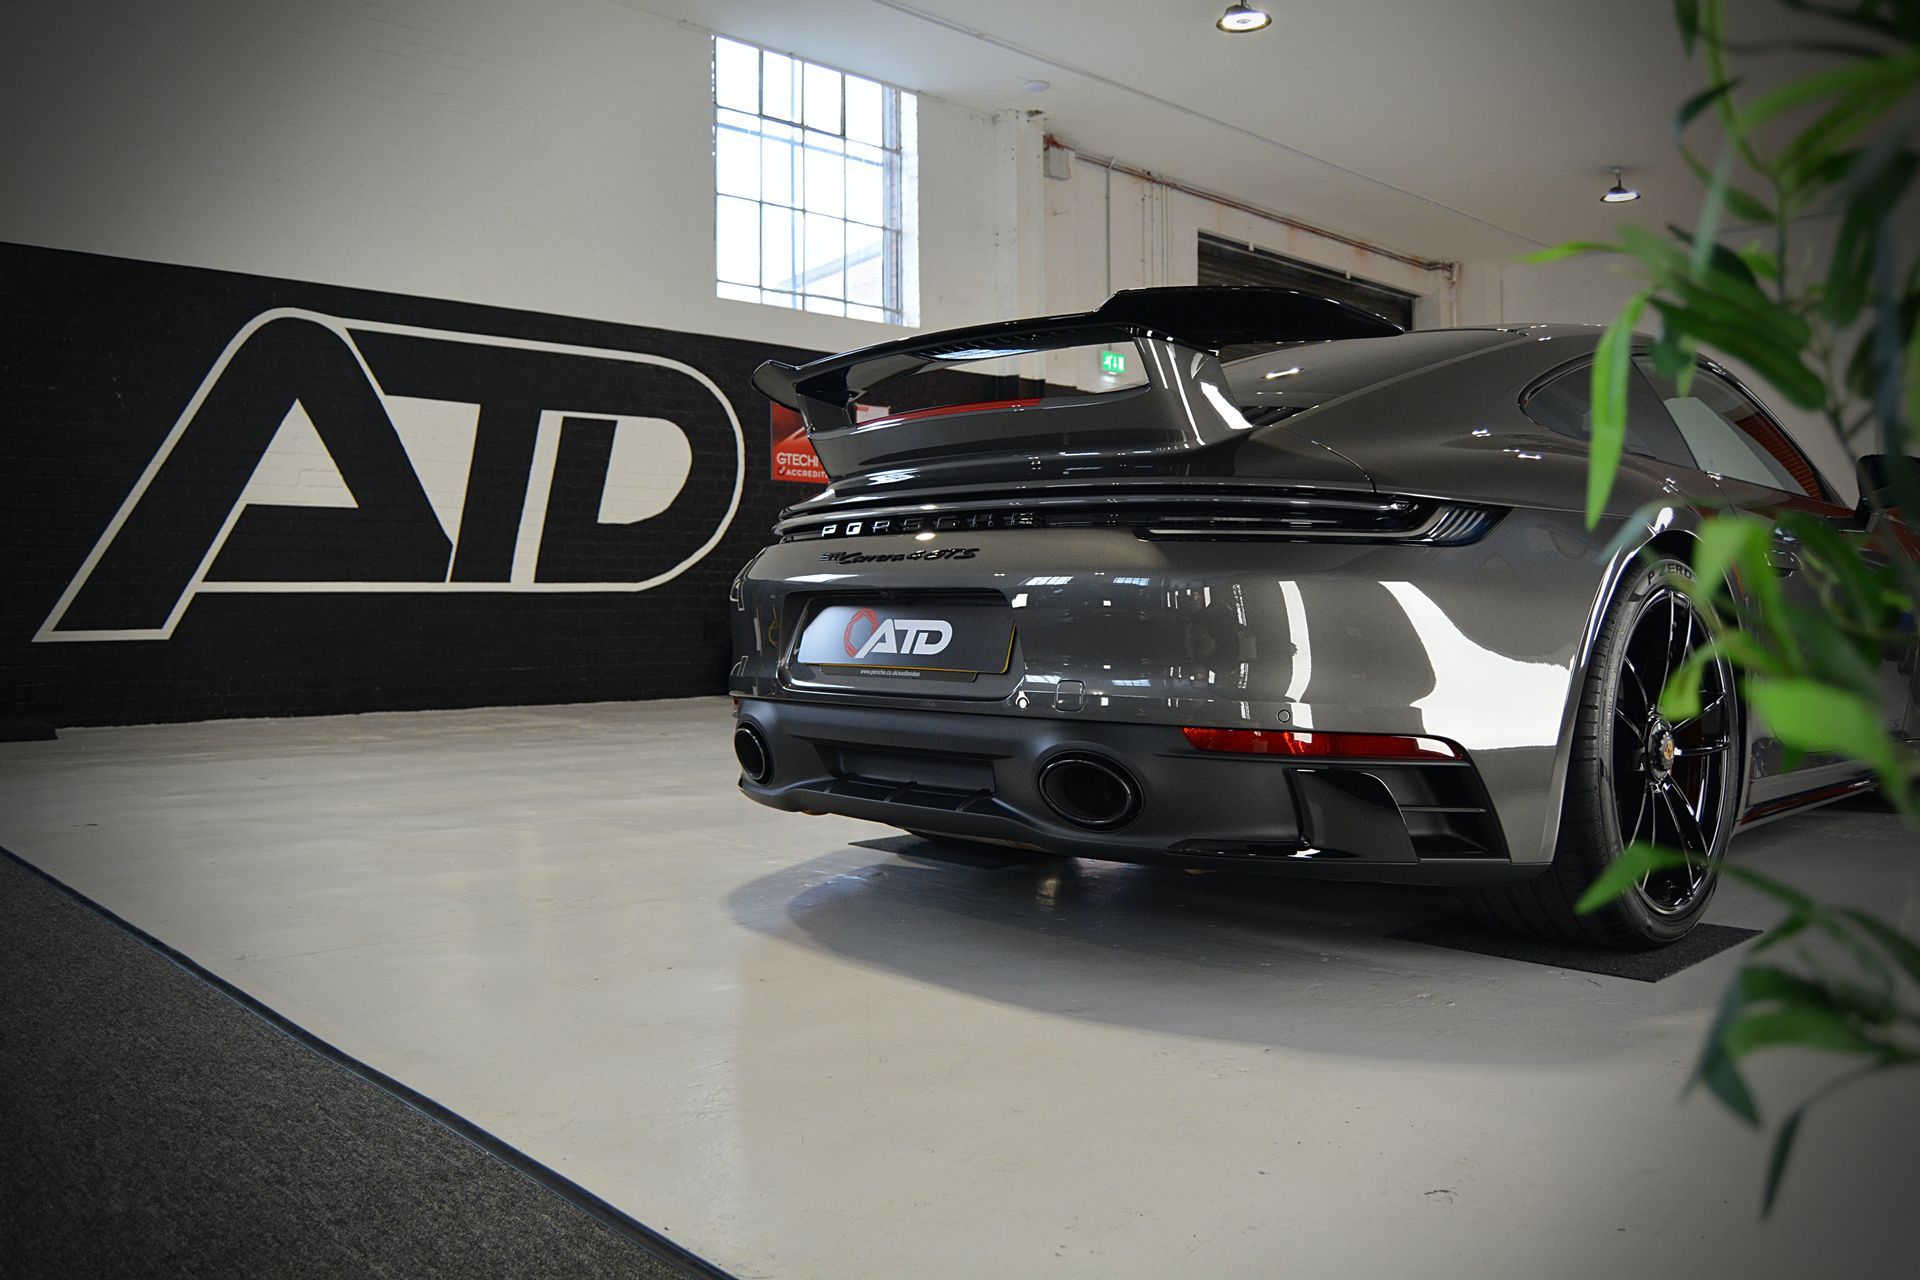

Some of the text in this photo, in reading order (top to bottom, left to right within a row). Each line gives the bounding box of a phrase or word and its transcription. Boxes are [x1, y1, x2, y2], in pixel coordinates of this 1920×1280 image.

[32, 307, 745, 642] ATD
[821, 512, 1044, 537] PORSCHE
[1647, 570, 1655, 586] P
[853, 618, 953, 659] ATD
